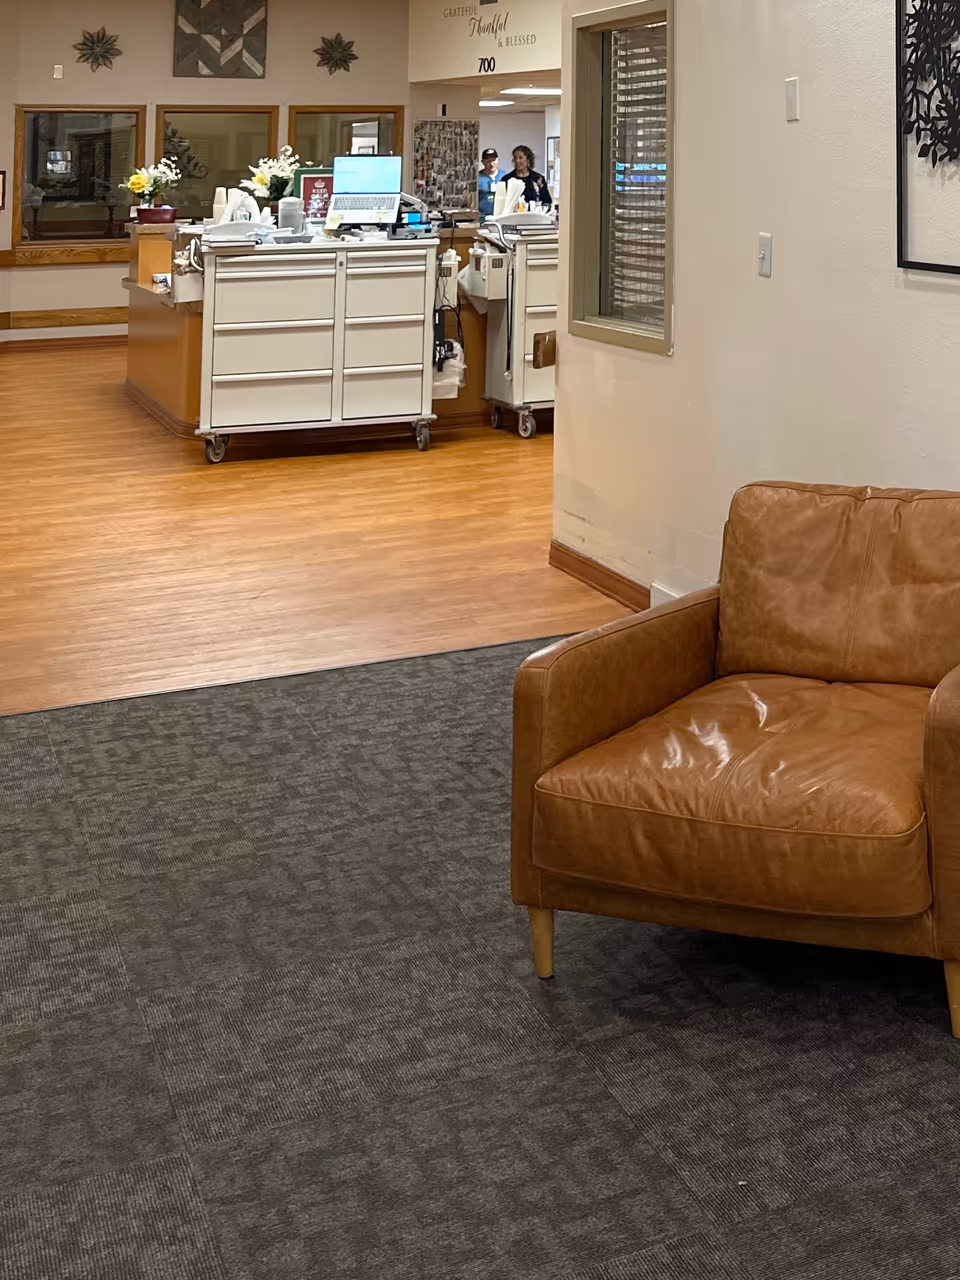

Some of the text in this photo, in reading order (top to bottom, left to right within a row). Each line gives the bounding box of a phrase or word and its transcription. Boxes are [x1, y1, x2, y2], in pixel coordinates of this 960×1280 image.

[443, 5, 478, 18] GRATEFUL
[469, 12, 510, 39] Thankful
[498, 34, 537, 48] & BLESSED
[478, 57, 496, 73] 700
